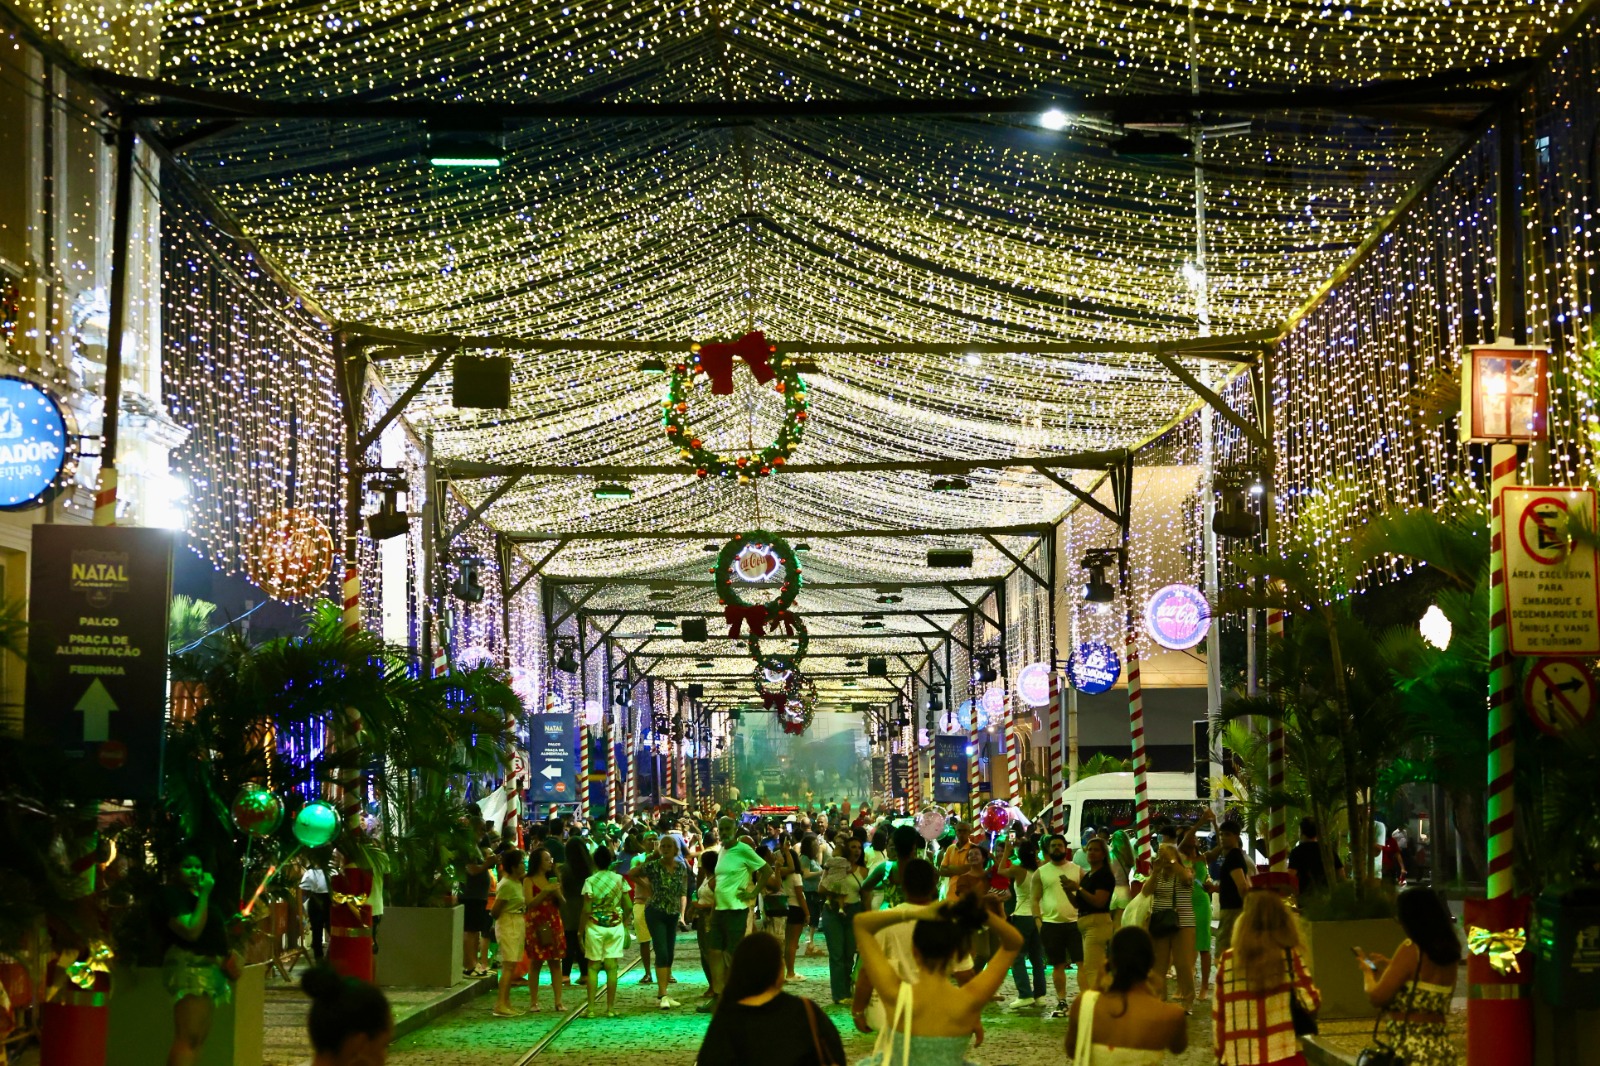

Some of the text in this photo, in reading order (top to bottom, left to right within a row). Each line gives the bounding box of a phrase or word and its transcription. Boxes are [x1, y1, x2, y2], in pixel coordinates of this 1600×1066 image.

[72, 563, 128, 581] NATAL
[1512, 568, 1535, 579] ÁREA
[1538, 583, 1563, 592] PARA
[1522, 597, 1582, 606] EMBARQUE E
[1512, 610, 1594, 619] DESEMBARQUE DE
[79, 617, 119, 627] PALCO
[1519, 622, 1590, 633] ÔNIBUS E VANS
[69, 634, 129, 646] PRAÇA DE
[1527, 637, 1582, 647] DE TURISMO
[56, 645, 141, 658] ALIMENTAÇÃO
[69, 664, 126, 676] FEIRINHA
